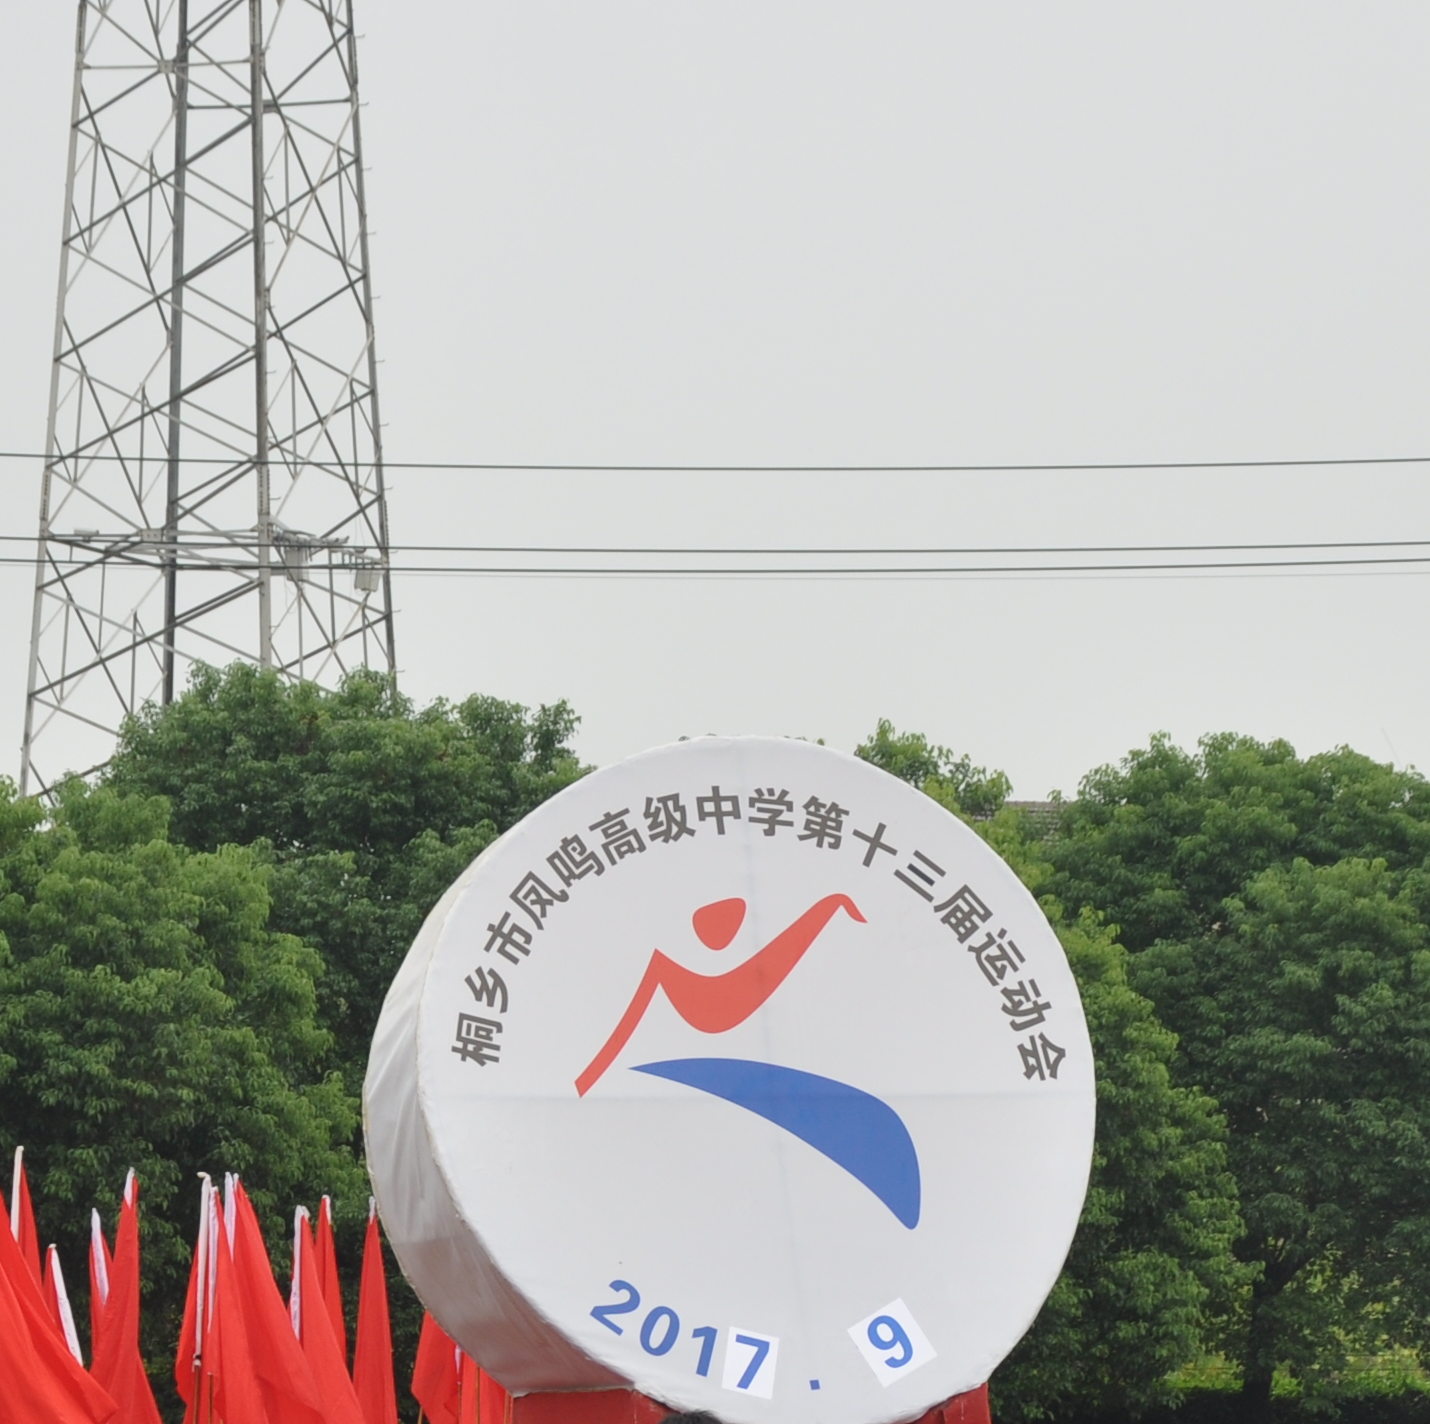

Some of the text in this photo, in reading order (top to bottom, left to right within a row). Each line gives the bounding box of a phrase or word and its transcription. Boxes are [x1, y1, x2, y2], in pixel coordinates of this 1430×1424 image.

[451, 786, 1067, 1082] 桐乡市凤鸣高级中学第十三届运动会
